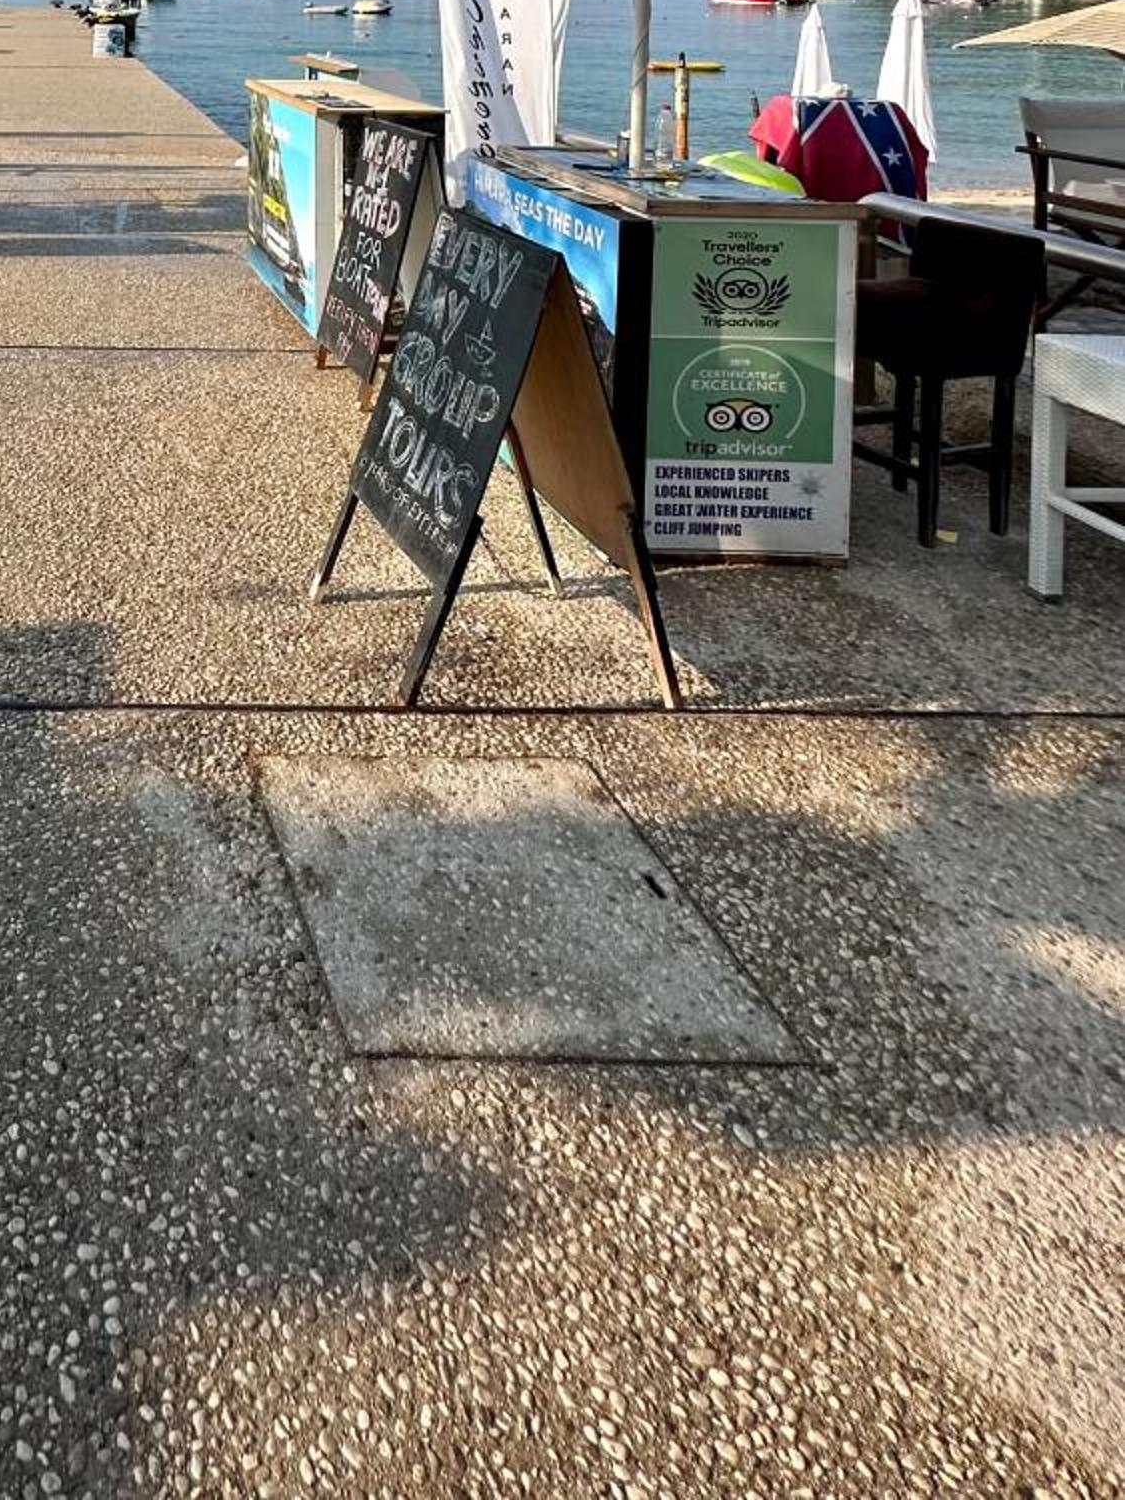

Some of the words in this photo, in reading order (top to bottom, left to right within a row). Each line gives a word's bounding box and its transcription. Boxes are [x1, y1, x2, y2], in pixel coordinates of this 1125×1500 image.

[362, 127, 388, 165] WE
[350, 185, 401, 239] RATED
[515, 193, 543, 222] SEAS
[545, 204, 572, 238] THE
[574, 218, 605, 250] DAY
[727, 231, 758, 240] 2020
[355, 230, 382, 271] FOR
[427, 211, 524, 309] EVERY
[712, 253, 772, 267] Choice
[336, 245, 373, 299] BOAT
[701, 315, 780, 329] Tripadvisor
[699, 369, 768, 380] CERTIFICATE
[392, 331, 500, 439] GROUP
[690, 379, 788, 393] EXCELLENCE
[685, 439, 789, 459] tripadvisor
[378, 397, 480, 531] TOURS
[654, 466, 736, 481] EXPERIENCED
[738, 469, 791, 483] SKIPERS
[654, 485, 692, 499] LOCAL
[694, 486, 770, 501] KNOWLEDGE
[654, 504, 693, 517] GREAT
[696, 505, 738, 518] WATER
[740, 505, 813, 520] EXPERIENCE
[654, 522, 685, 535] CLIFF
[688, 523, 743, 537] JUMPING
